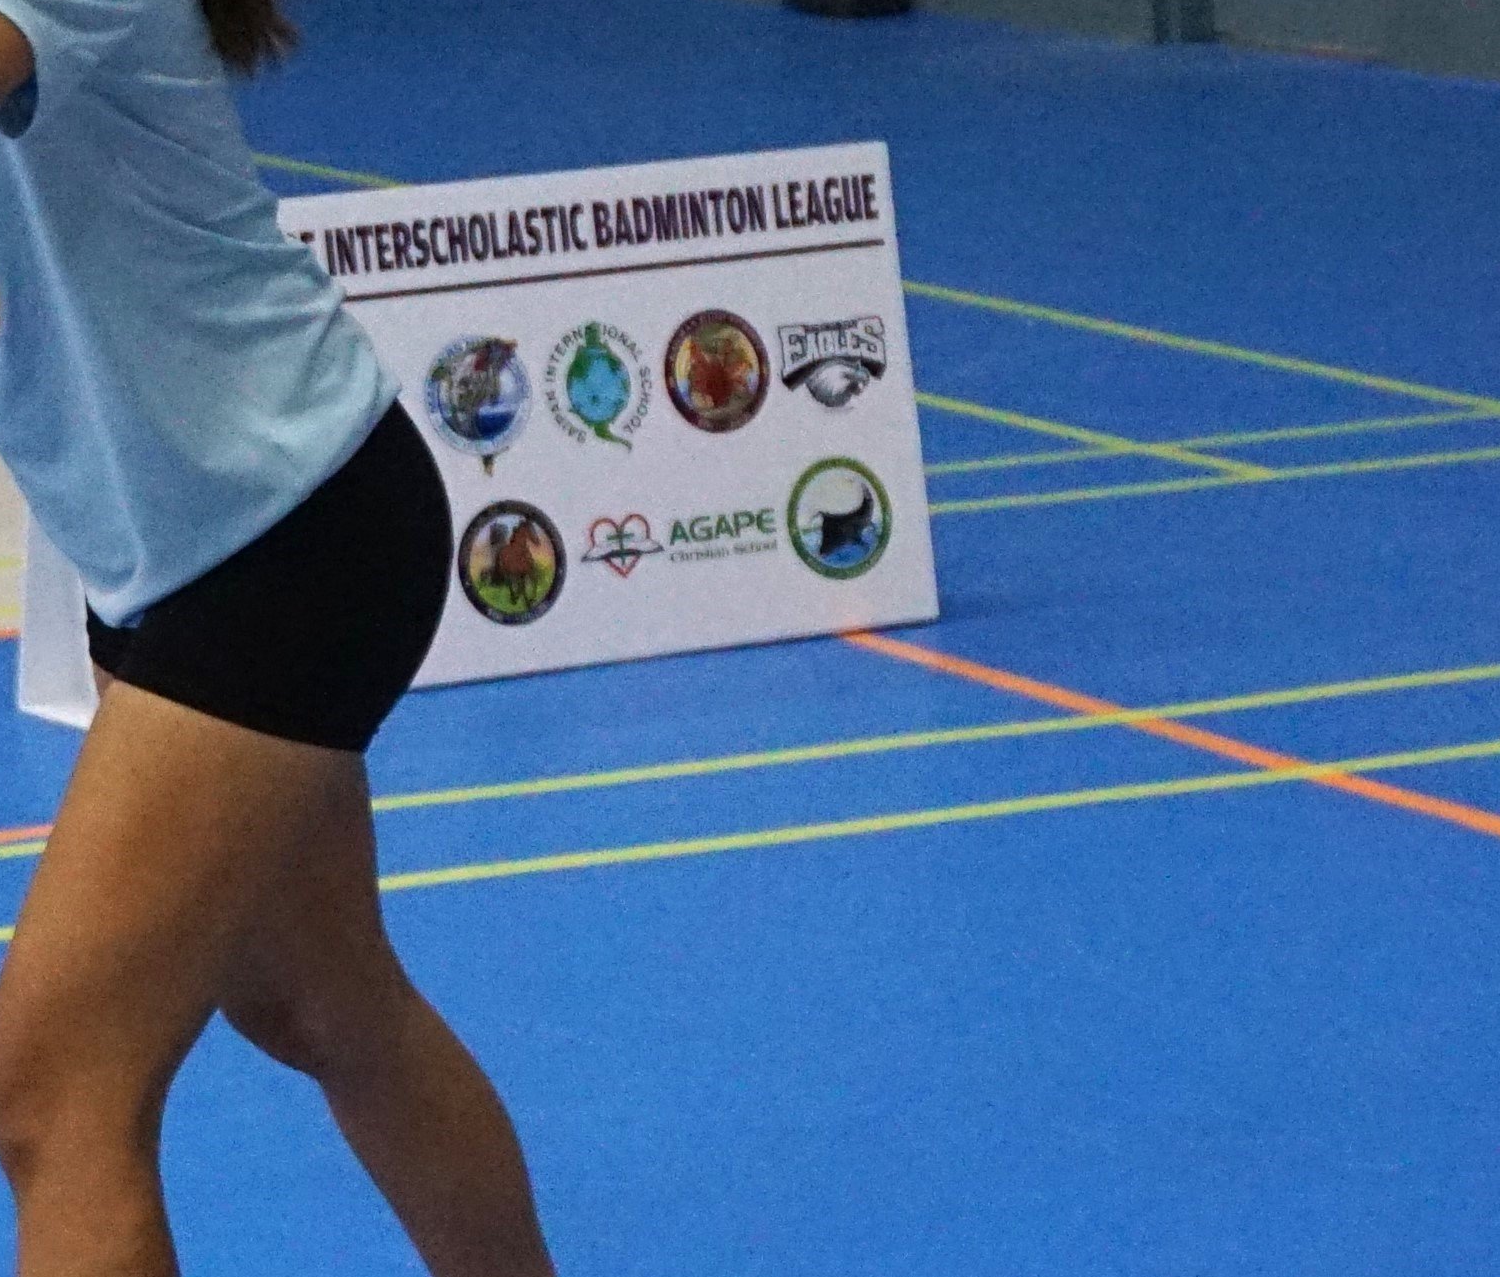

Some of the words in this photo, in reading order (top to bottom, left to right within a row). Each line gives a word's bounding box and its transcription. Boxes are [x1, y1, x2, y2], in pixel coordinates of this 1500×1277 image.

[324, 202, 588, 275] INTERSCHOLASTIC
[592, 184, 767, 247] BADMINTON
[772, 173, 879, 229] LEAGUE
[544, 324, 643, 383] INTERNIONAL
[669, 507, 777, 546] AGAPE
